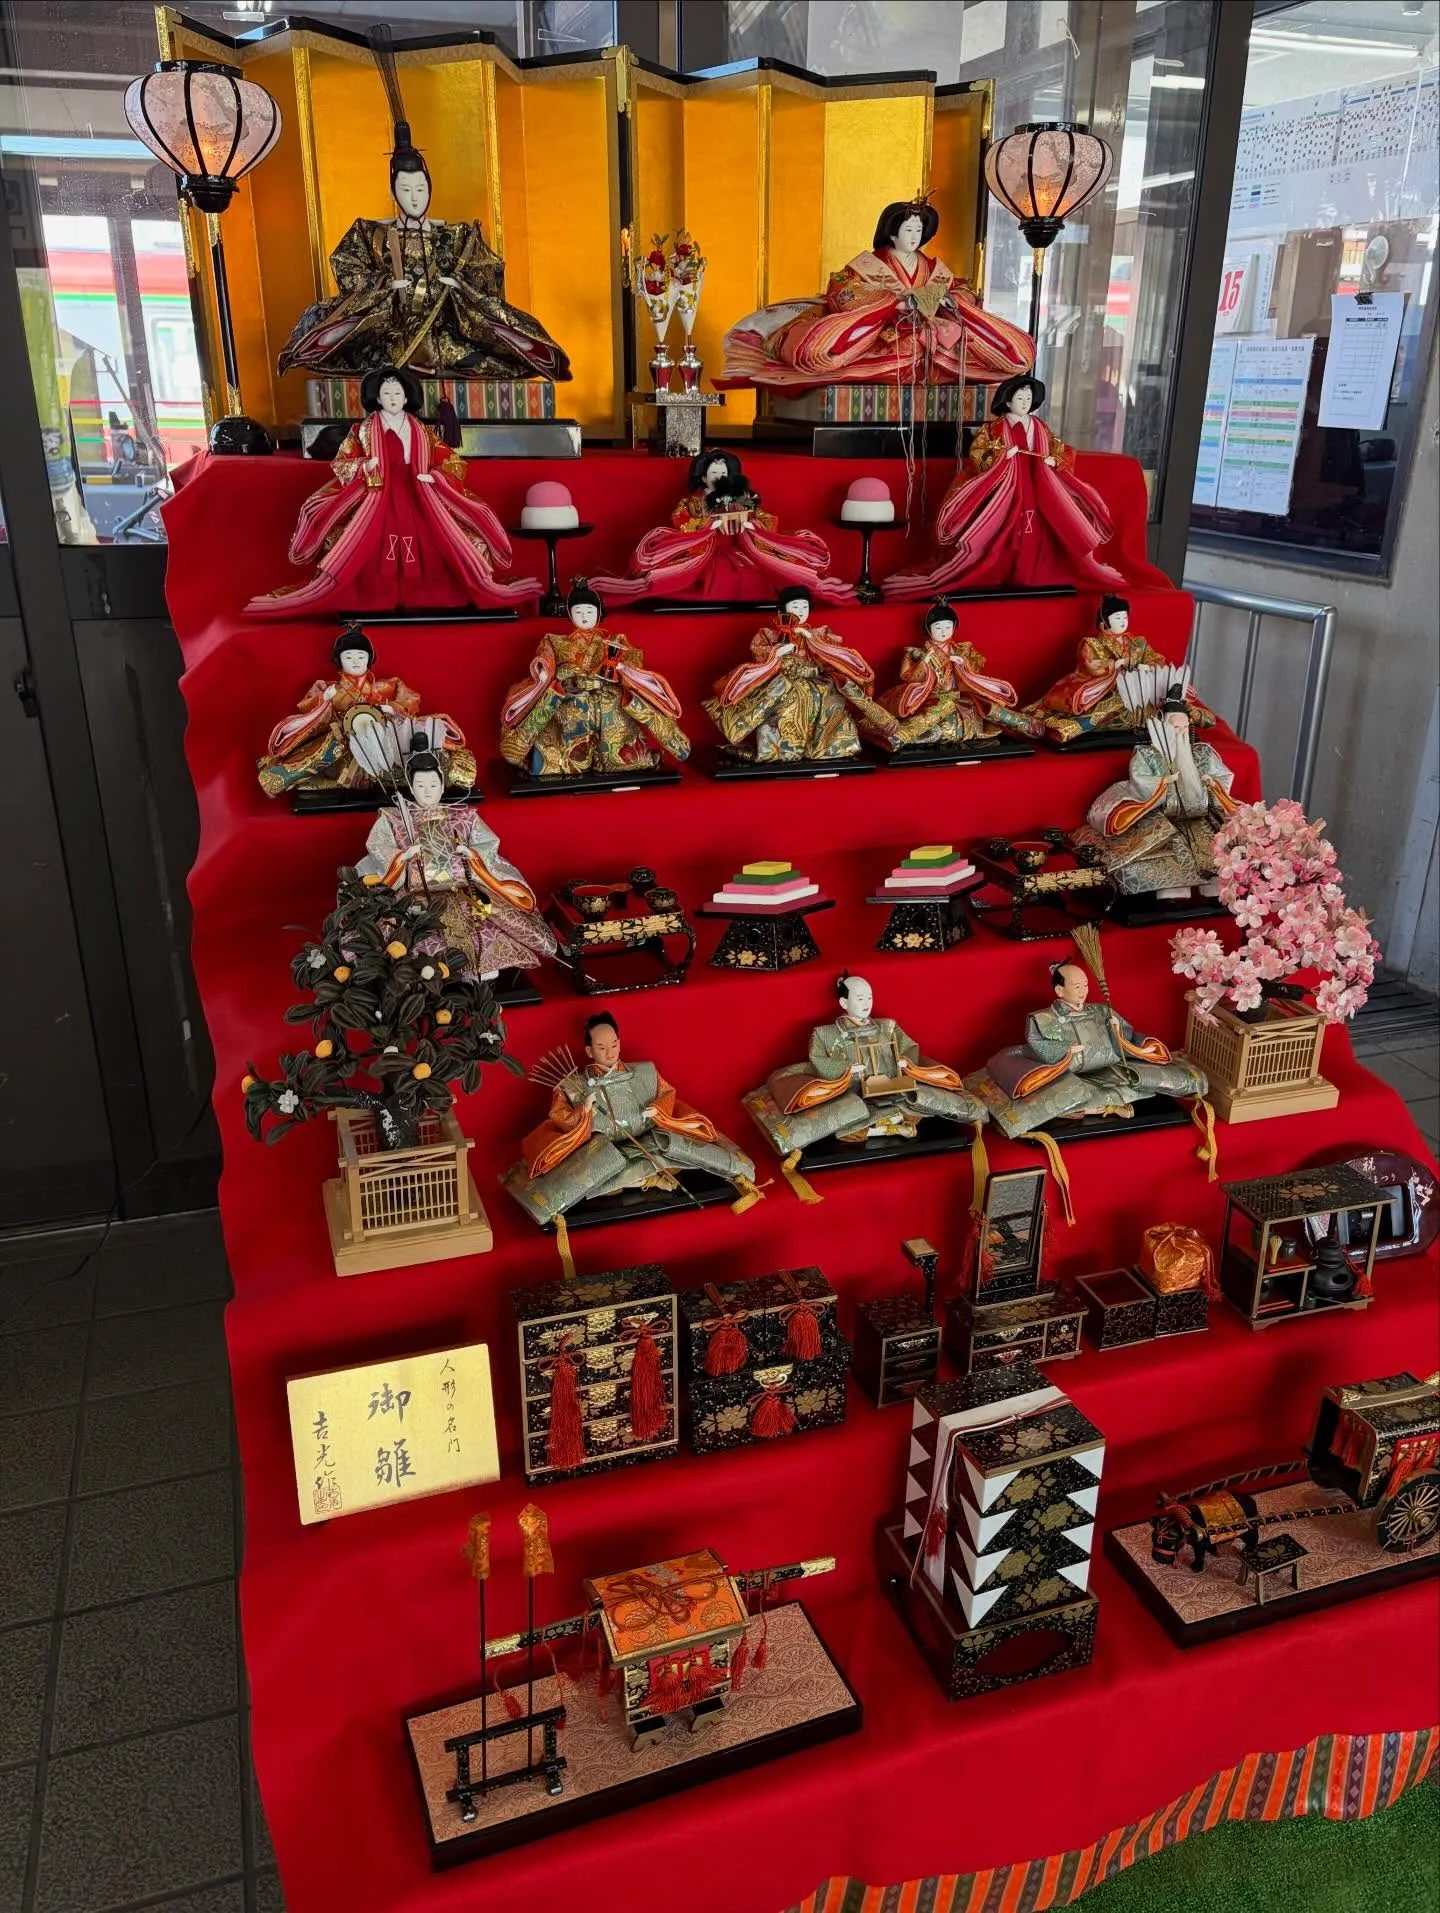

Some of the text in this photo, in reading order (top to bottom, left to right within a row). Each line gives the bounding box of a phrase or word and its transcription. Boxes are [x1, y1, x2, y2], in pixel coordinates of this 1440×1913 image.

[1218, 270, 1244, 311] 15
[1362, 1156, 1376, 1172] 祝
[367, 1382, 417, 1488] 御雛
[439, 1358, 461, 1454] 人形の名門
